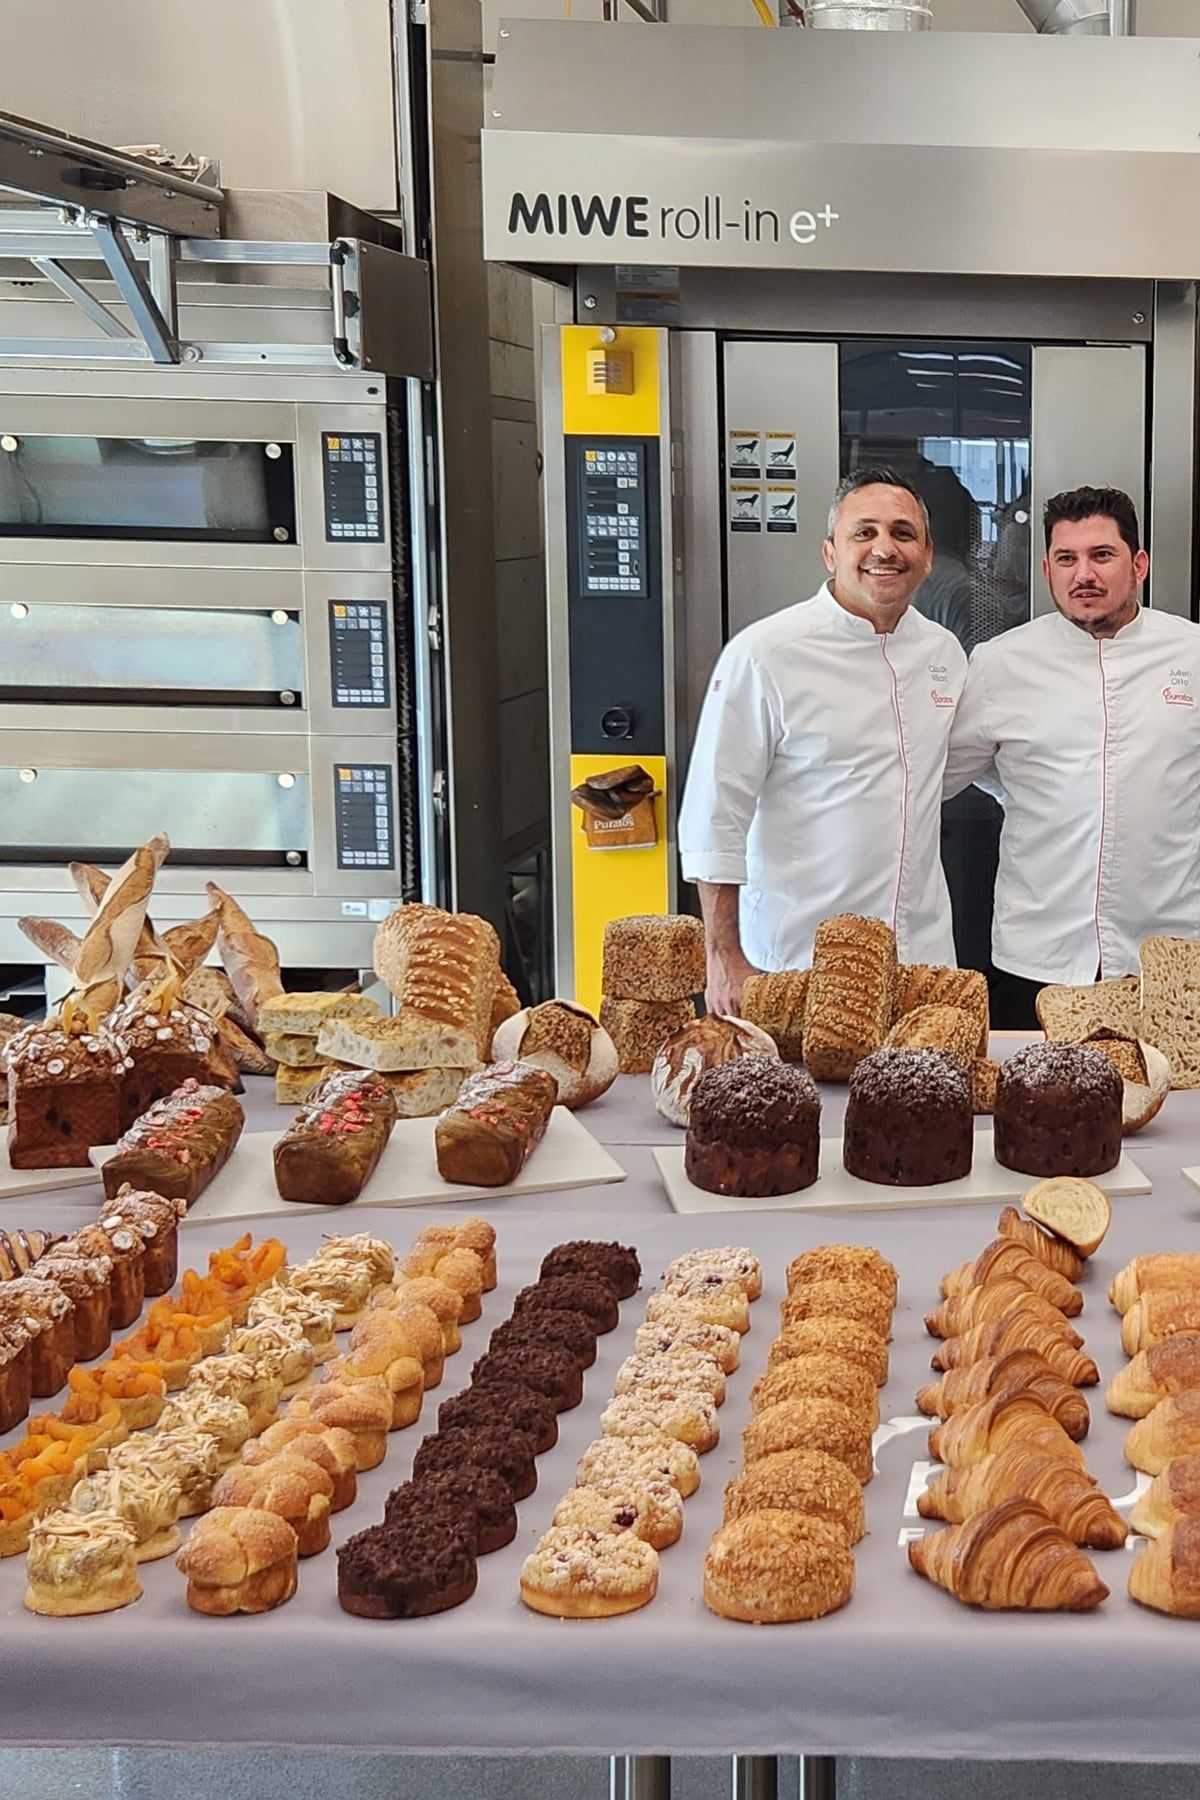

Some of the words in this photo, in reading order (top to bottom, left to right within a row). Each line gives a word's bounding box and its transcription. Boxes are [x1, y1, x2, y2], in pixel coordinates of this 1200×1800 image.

[508, 192, 649, 237] MIWE
[660, 195, 779, 242] roll-in
[789, 203, 839, 244] e+
